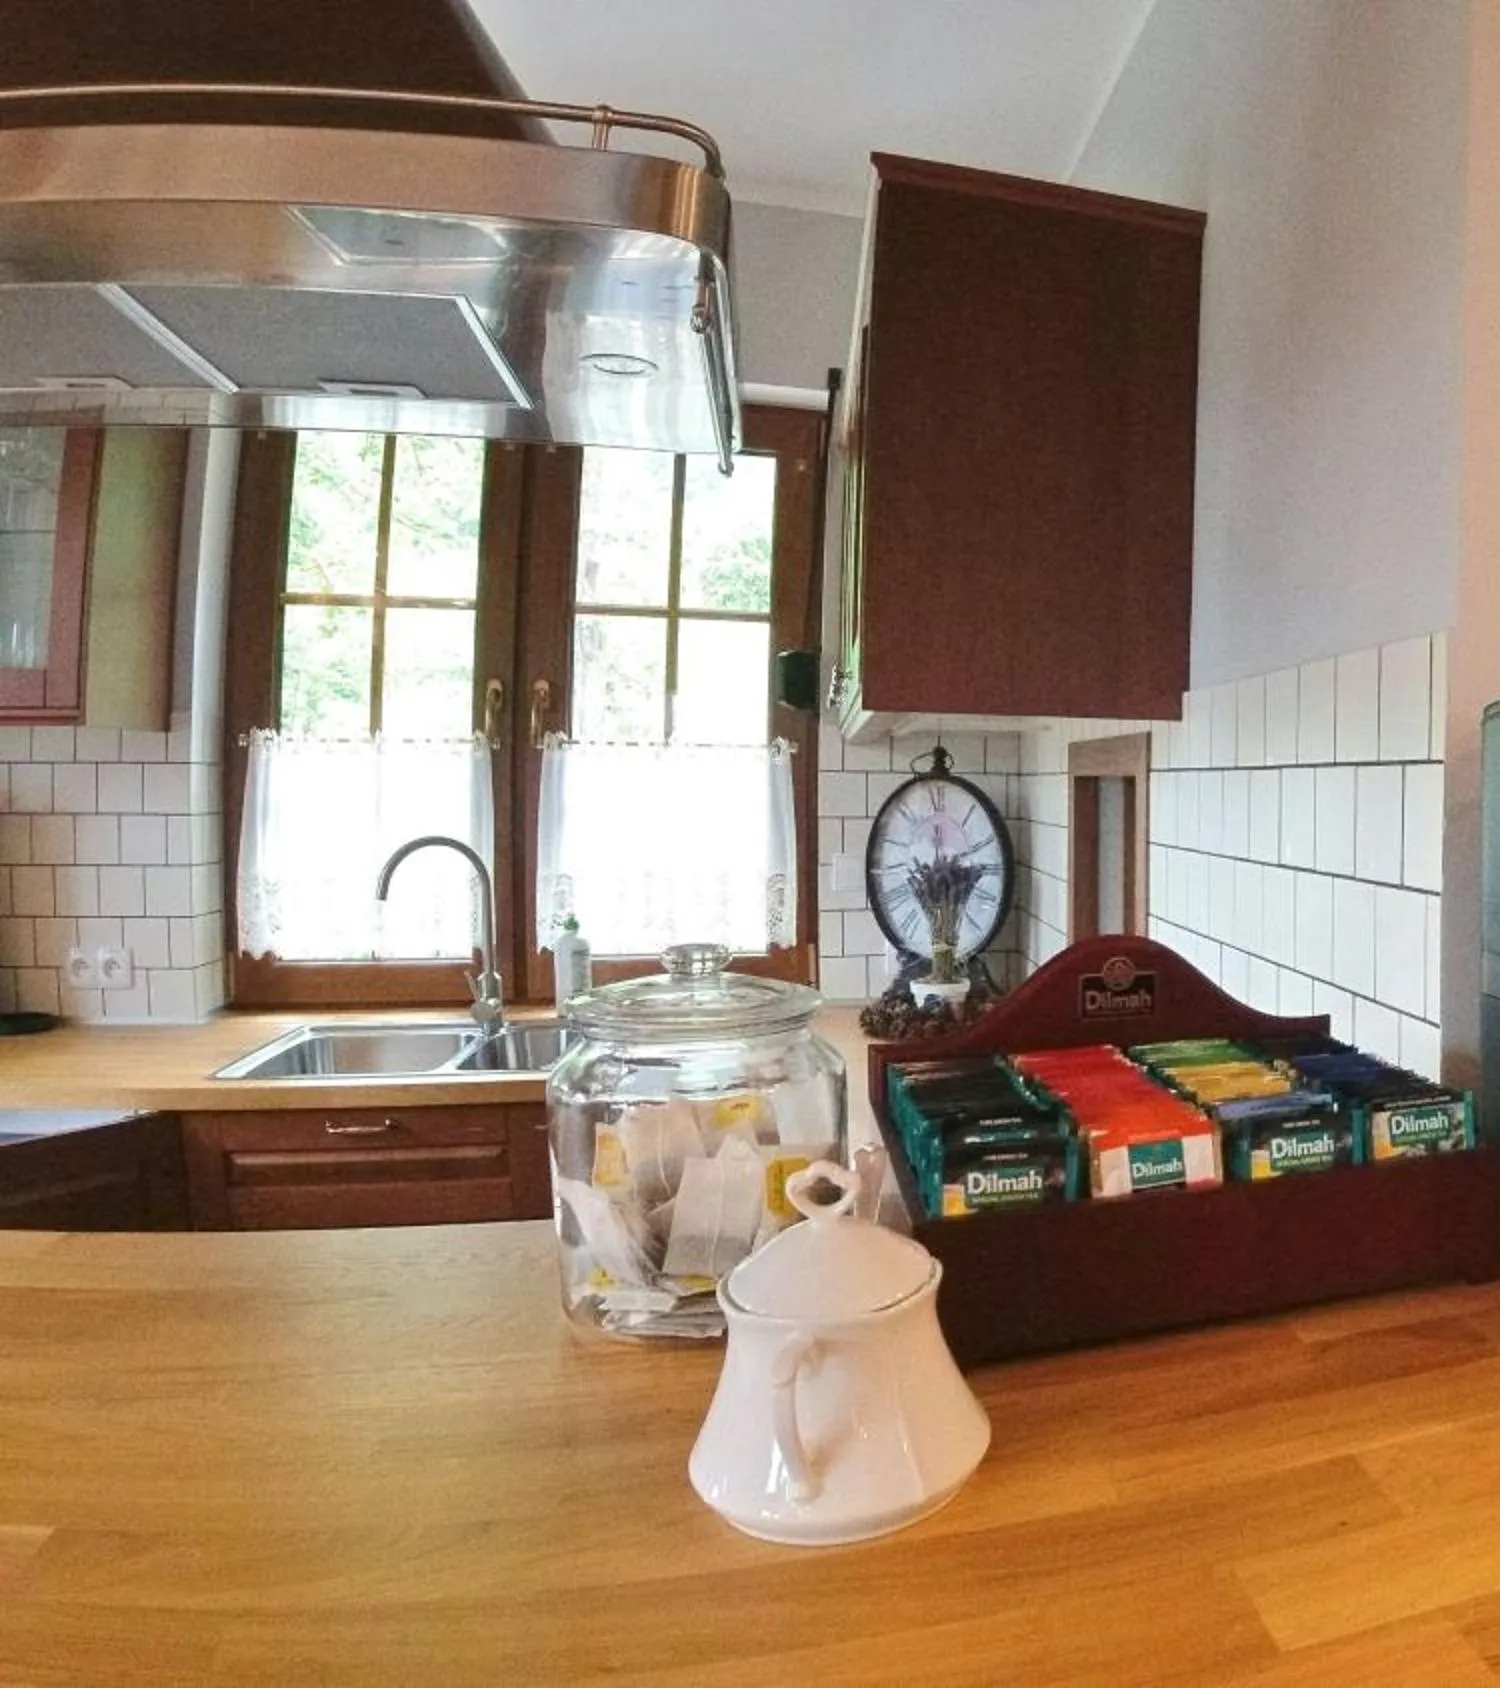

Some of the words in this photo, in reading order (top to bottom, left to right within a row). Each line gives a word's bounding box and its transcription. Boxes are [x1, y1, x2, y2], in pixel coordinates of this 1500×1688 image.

[1085, 988, 1153, 1011] Dilmah
[1390, 1110, 1449, 1136] Dilmah
[1271, 1131, 1335, 1159] Dilmah
[1132, 1157, 1183, 1179] Dilmah
[967, 1168, 1042, 1195] Dilmah
